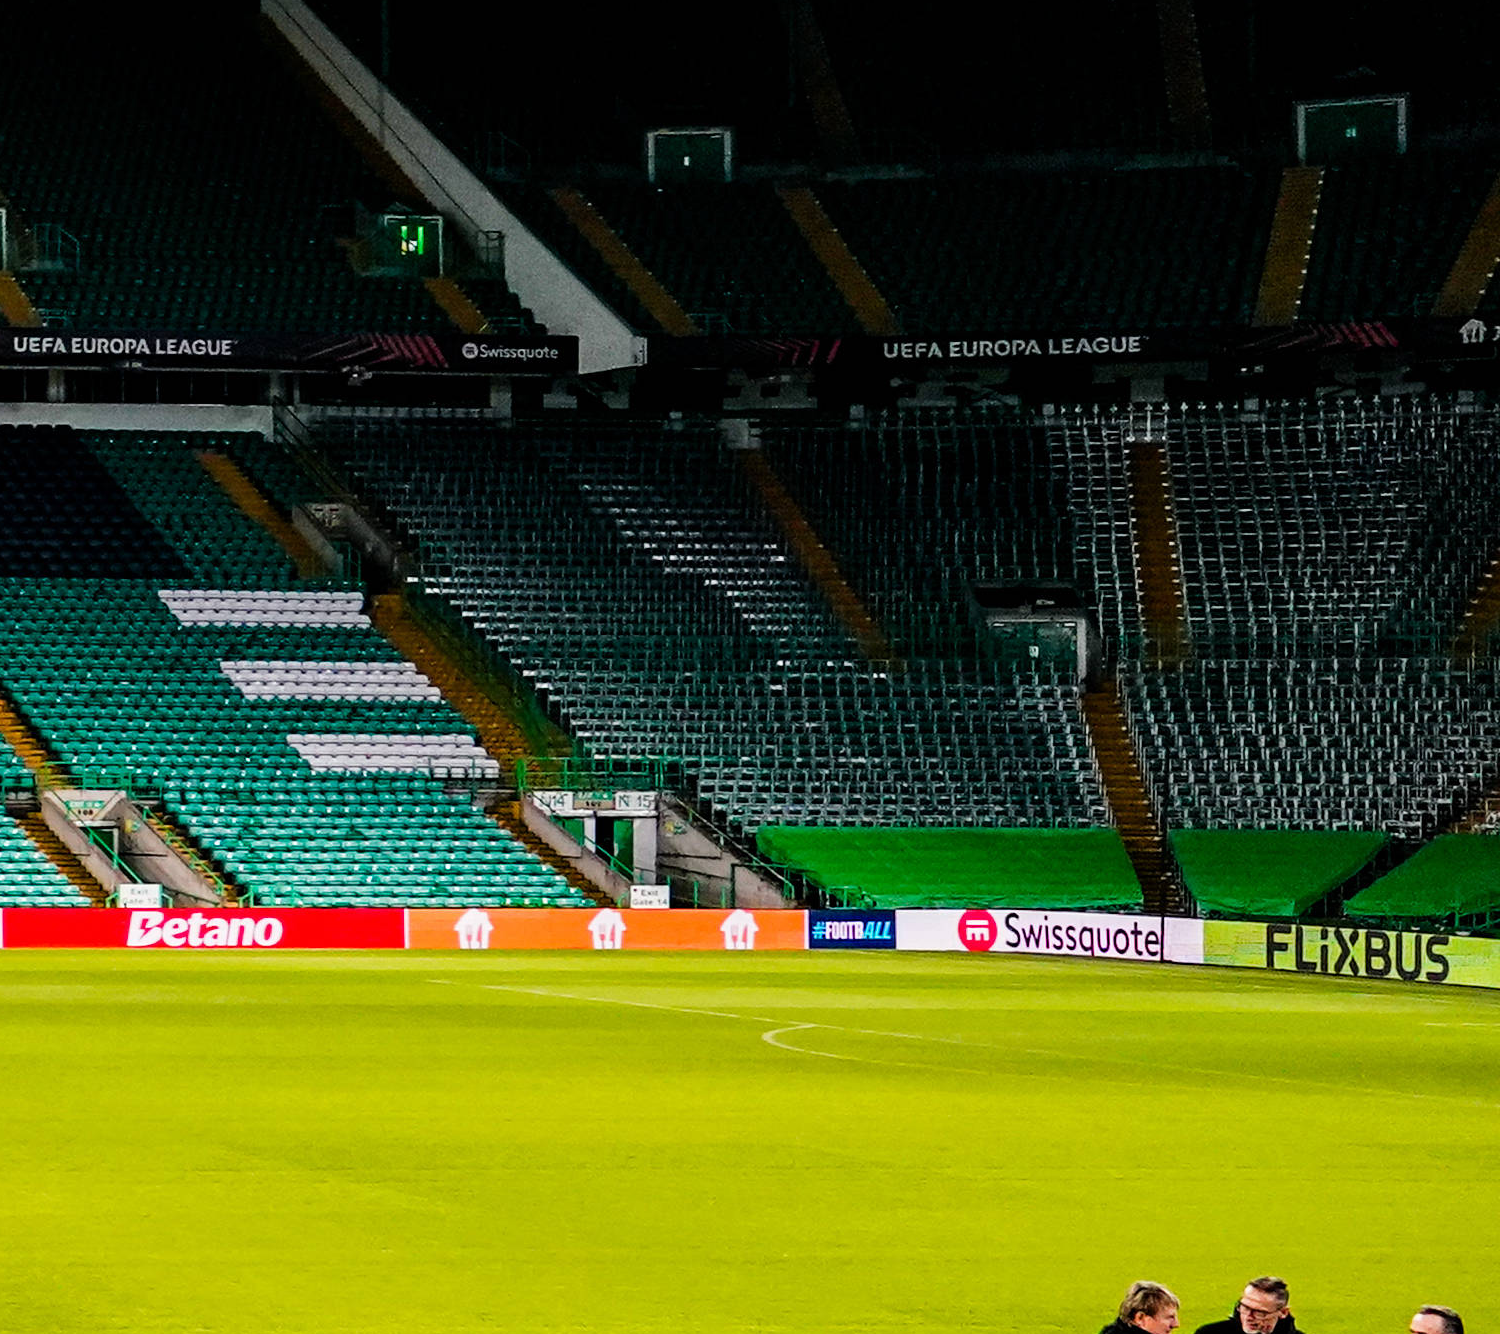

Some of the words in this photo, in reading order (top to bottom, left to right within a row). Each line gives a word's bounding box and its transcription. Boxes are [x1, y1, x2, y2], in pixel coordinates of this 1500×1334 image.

[14, 336, 66, 354] UEFA
[72, 337, 150, 355] EUROPA
[479, 343, 559, 361] Swissquote
[884, 342, 942, 359] UEFA
[950, 339, 1041, 358] EUROPA
[126, 910, 283, 947] Betano
[811, 920, 892, 941] #FOOTBALL
[1004, 912, 1160, 958] Swissquote
